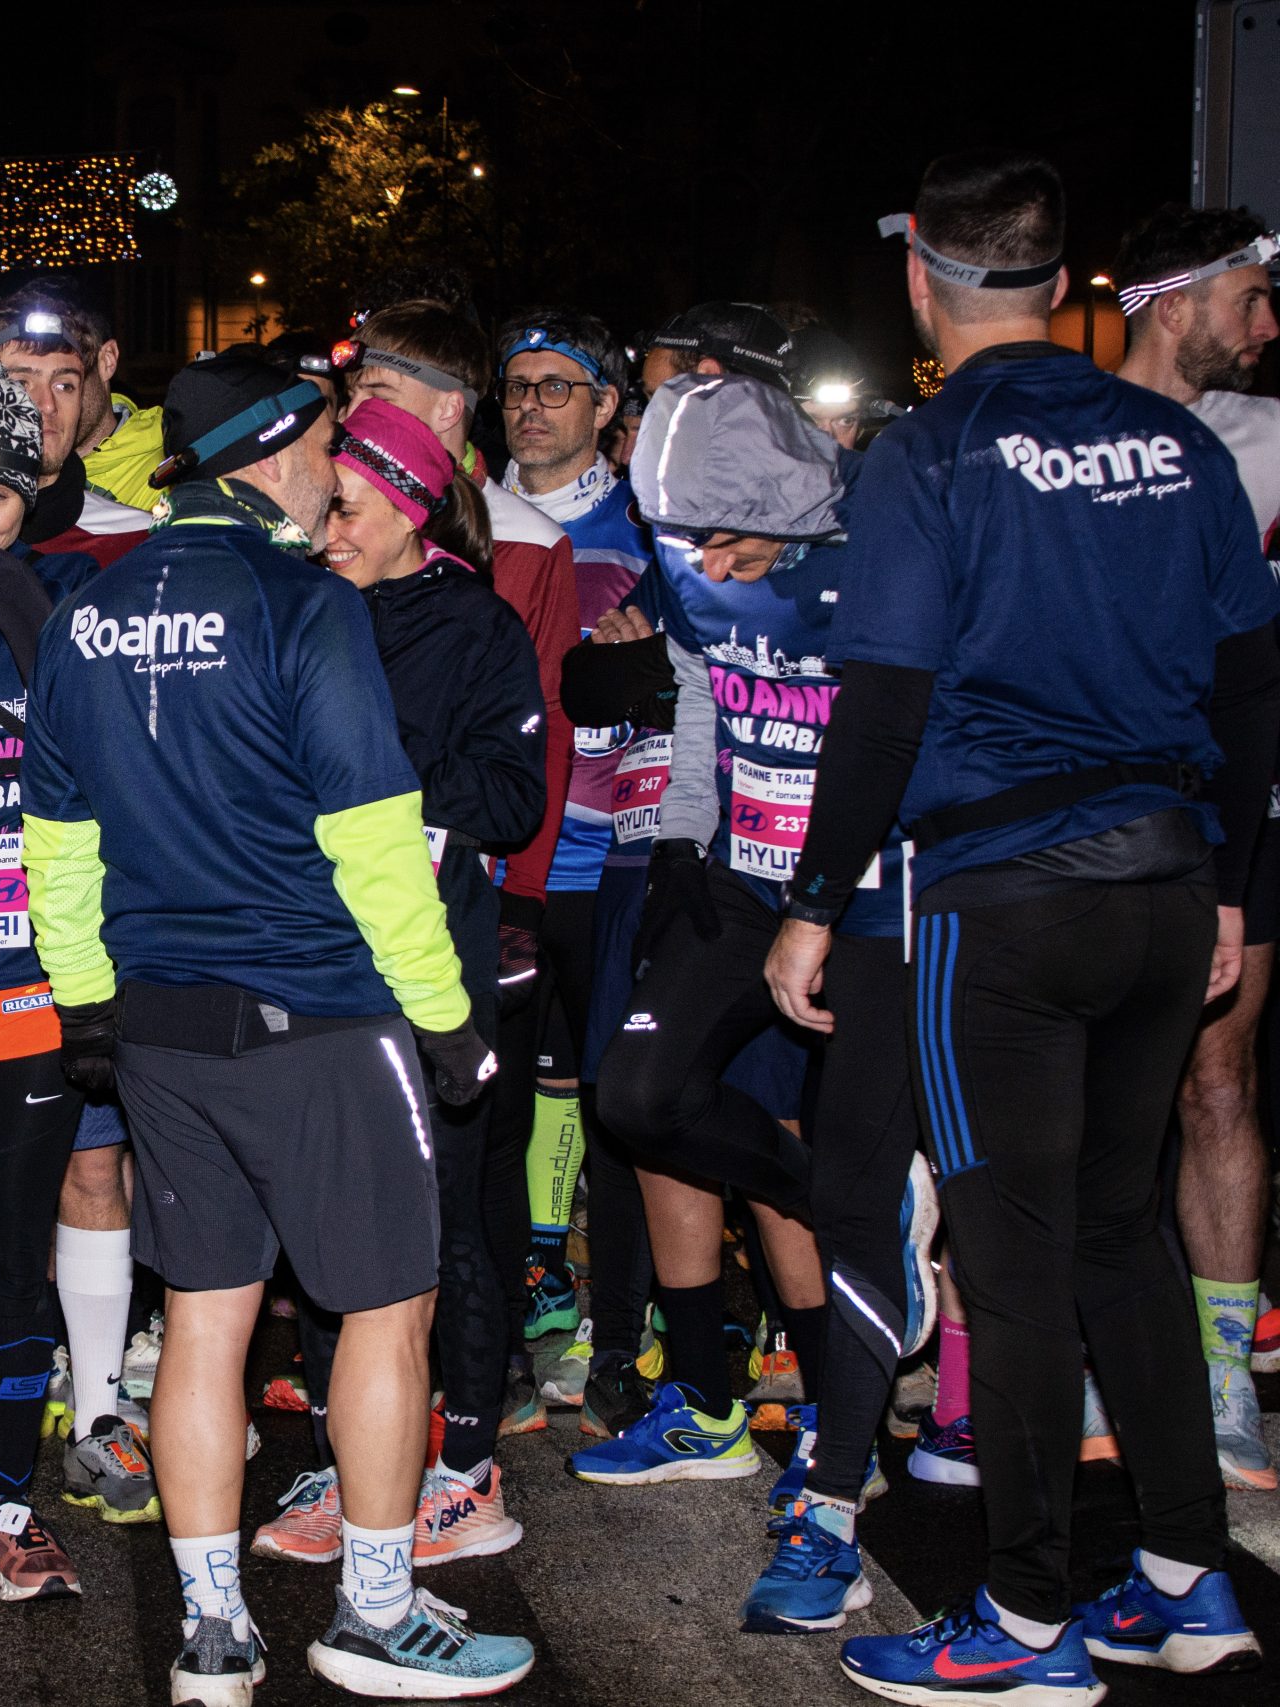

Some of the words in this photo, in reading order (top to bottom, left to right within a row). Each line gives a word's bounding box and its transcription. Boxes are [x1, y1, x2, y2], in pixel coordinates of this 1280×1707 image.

[365, 352, 421, 375] Energizer
[259, 413, 296, 443] odlo
[996, 433, 1184, 492] Roanne
[1147, 475, 1193, 500] sport
[70, 604, 225, 660] Roanne
[134, 656, 184, 678] L'esprit
[187, 655, 227, 677] sport
[638, 776, 662, 793] 247
[738, 762, 772, 783] ROANNE
[775, 772, 815, 785] TRAIL
[774, 814, 810, 833] 237
[425, 1496, 477, 1533] HOKA
